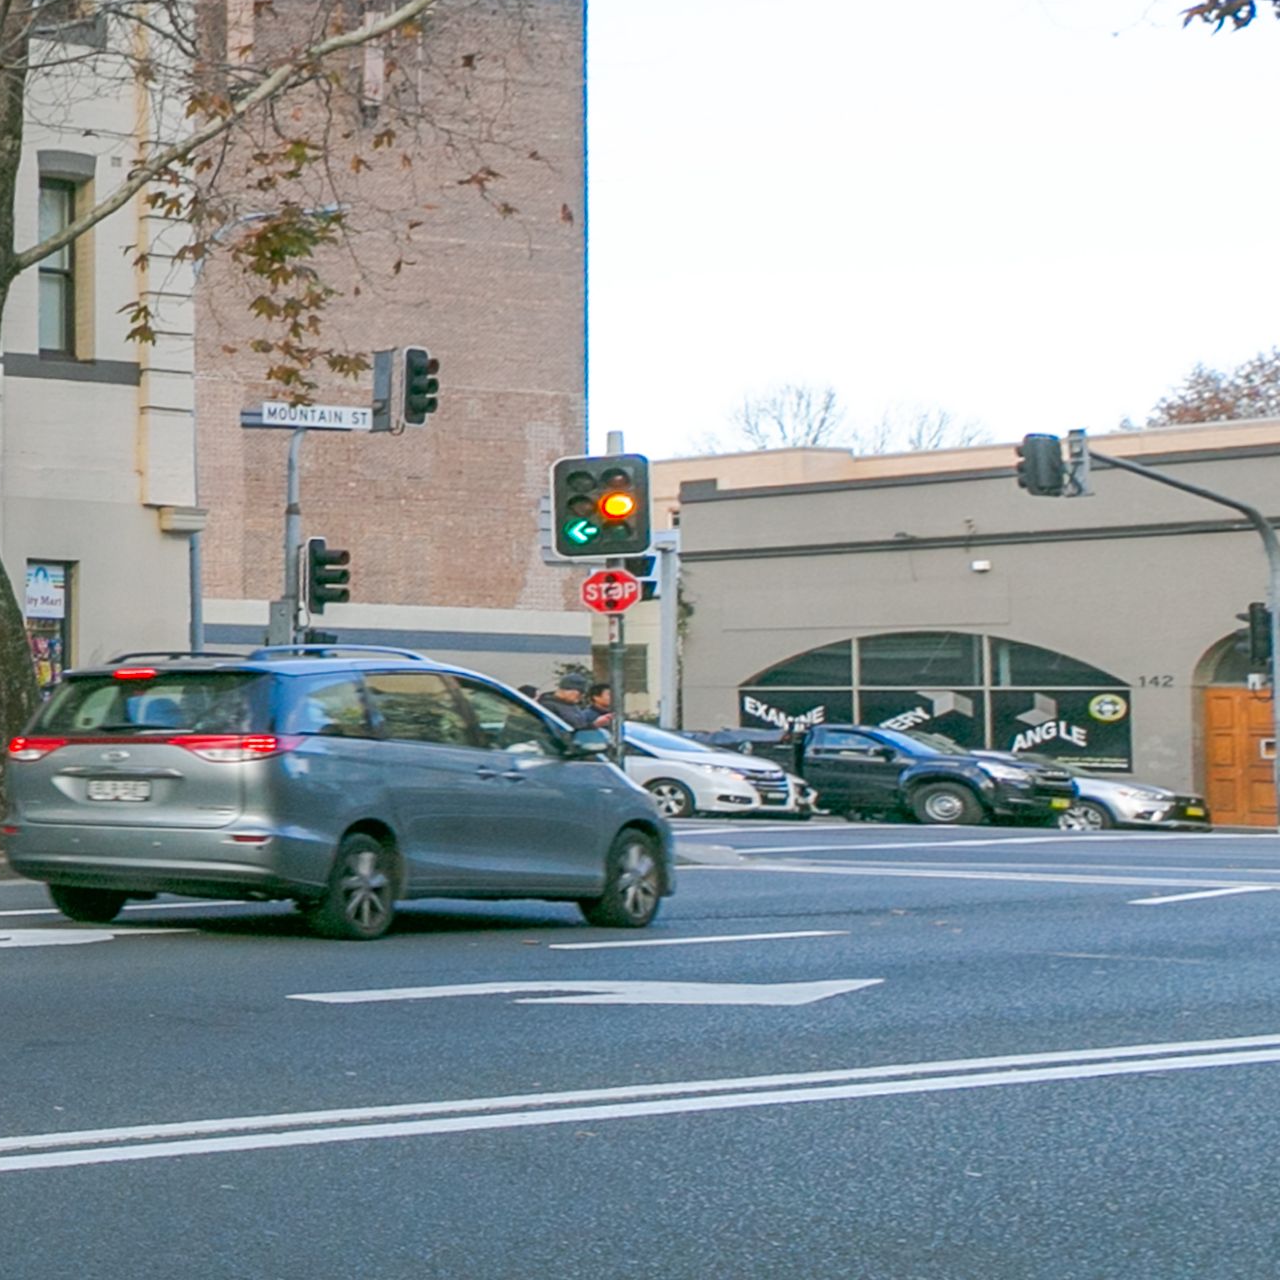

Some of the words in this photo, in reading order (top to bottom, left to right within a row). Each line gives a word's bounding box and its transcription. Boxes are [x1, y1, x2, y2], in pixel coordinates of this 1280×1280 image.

[266, 407, 343, 423] MOUNTAIN
[351, 412, 368, 425] ST
[585, 583, 637, 601] STOP
[1139, 675, 1174, 687] 142
[1012, 721, 1088, 753] ANGLE
